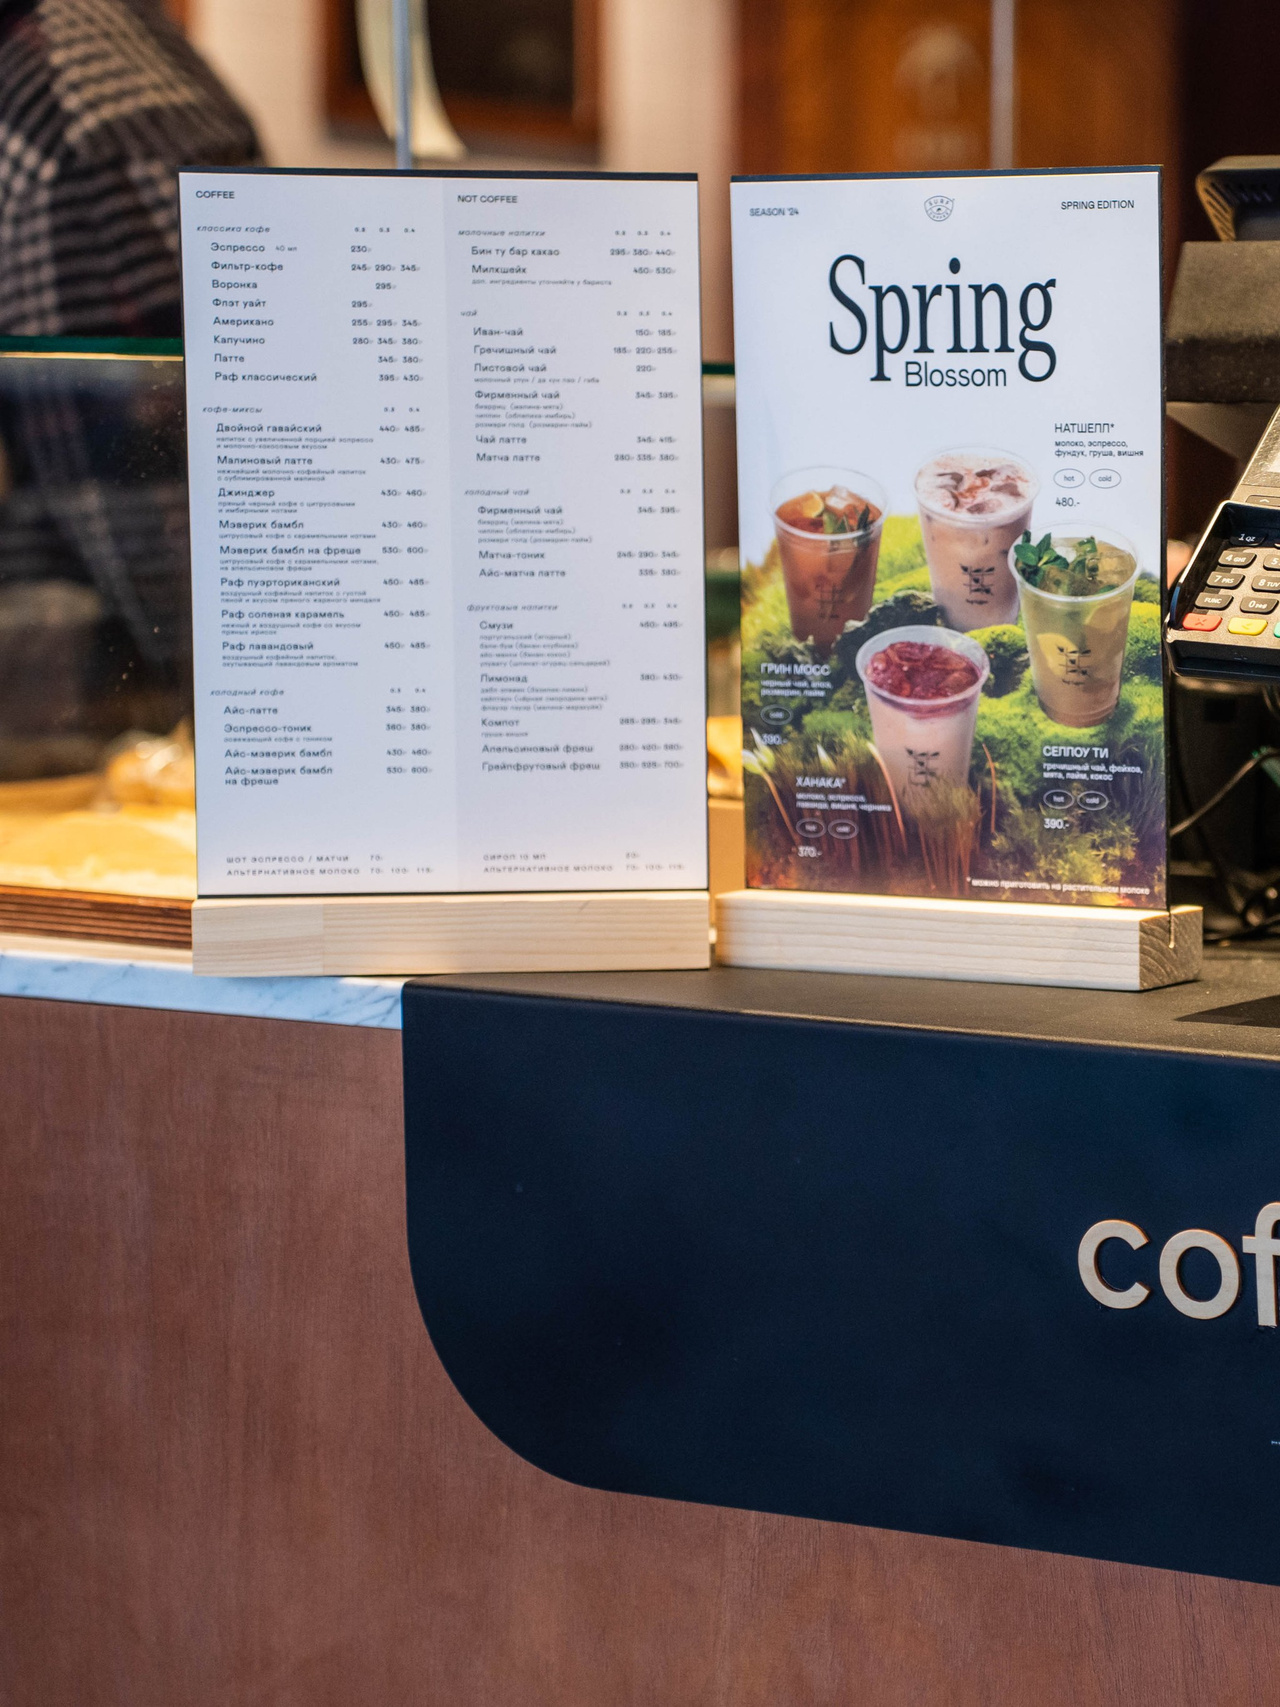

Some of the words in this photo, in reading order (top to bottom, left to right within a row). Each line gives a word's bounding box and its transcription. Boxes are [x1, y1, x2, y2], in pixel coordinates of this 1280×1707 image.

[196, 191, 235, 199] COFFEE
[1061, 201, 1095, 211] SPRING
[1098, 200, 1135, 209] EDITION
[750, 207, 785, 217] SEASON
[245, 225, 270, 233] кофе
[211, 243, 265, 253] Эспрессо
[211, 262, 283, 272] Фильтр-кофе
[212, 280, 258, 290] Воронка
[212, 299, 239, 308] Флэт
[243, 299, 266, 309] уайт
[213, 317, 274, 327] Американо
[828, 254, 1057, 382] Spring
[214, 335, 265, 346] Капучино
[214, 354, 244, 363] Латте
[215, 373, 238, 382] Раф
[242, 372, 317, 382] классический
[905, 361, 1007, 387] Blossom
[1055, 440, 1085, 448] молоко,
[1088, 440, 1128, 448] эспрессо,
[1055, 449, 1087, 458] фундук,
[1118, 449, 1144, 457] вишня
[1055, 497, 1080, 507] 480.-
